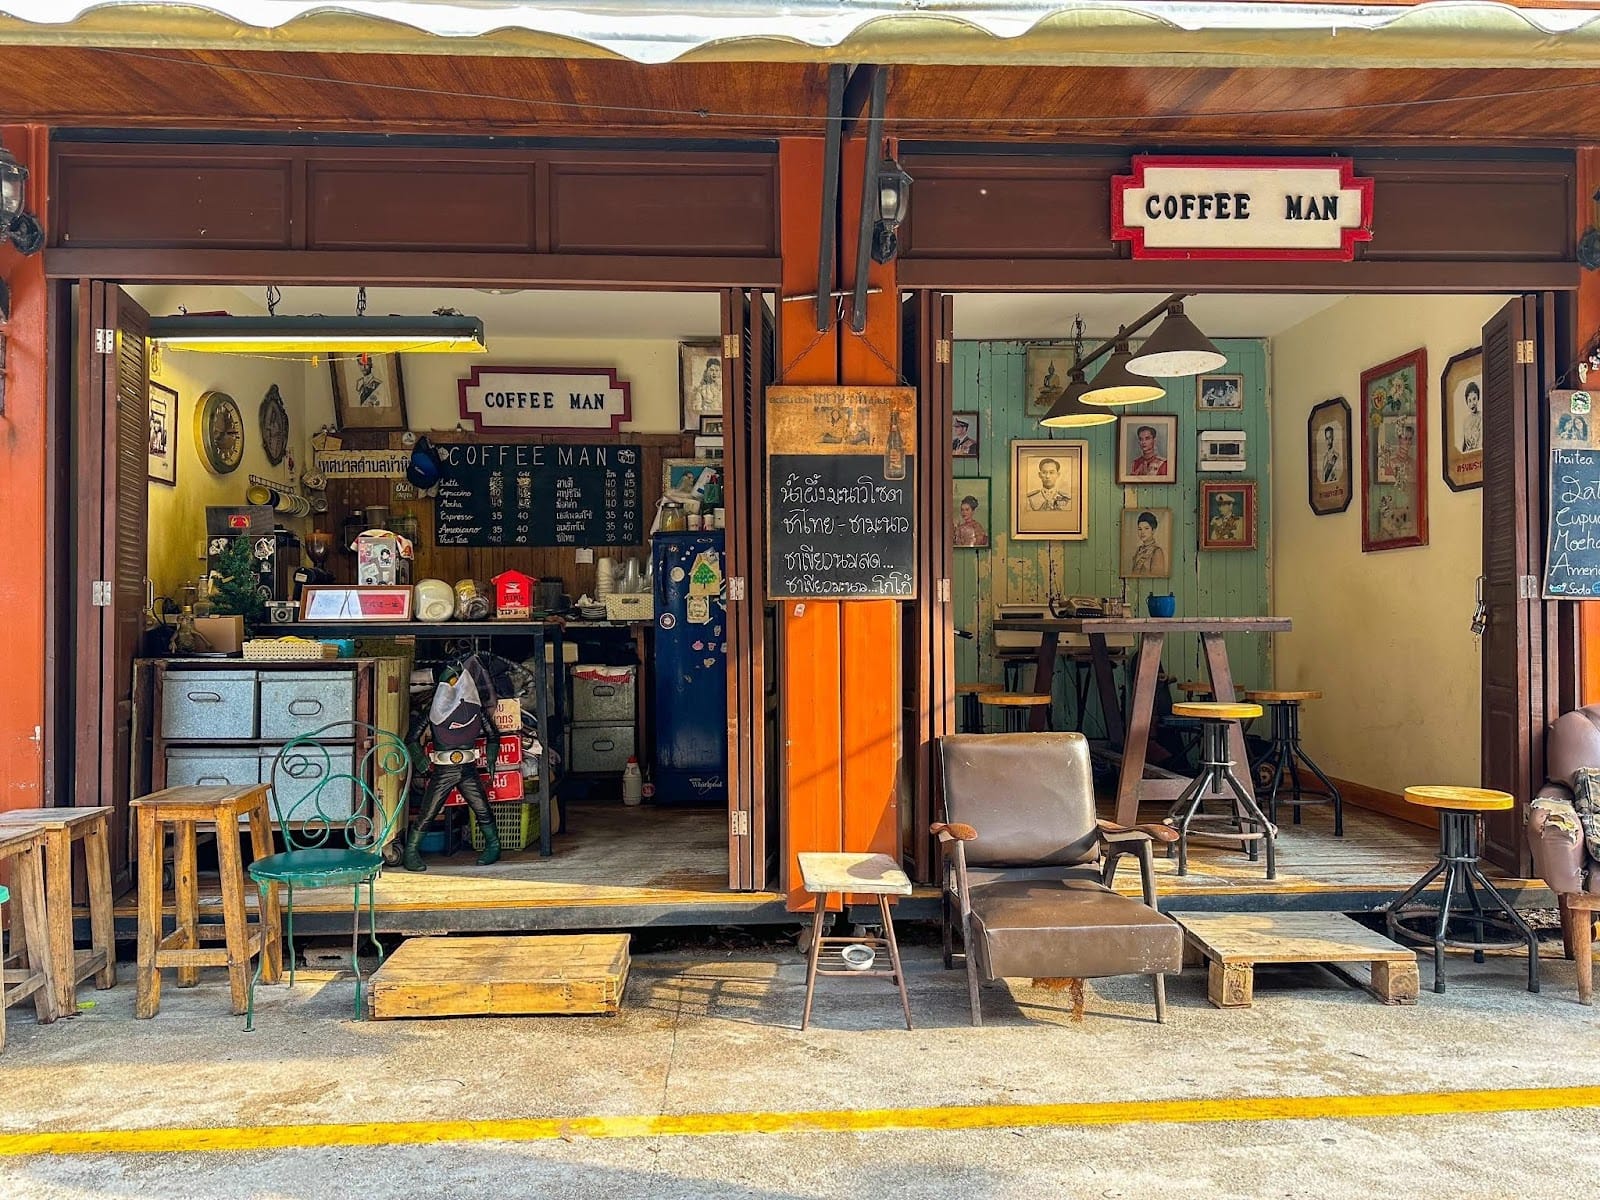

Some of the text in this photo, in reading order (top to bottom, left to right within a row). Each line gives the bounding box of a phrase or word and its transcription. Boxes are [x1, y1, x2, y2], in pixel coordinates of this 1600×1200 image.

[1145, 193, 1338, 221] COFFEE MAN
[485, 392, 604, 410] COFFEE MAN
[450, 445, 607, 466] COFFEE MAN
[605, 479, 616, 488] 40
[605, 499, 616, 508] 40
[491, 511, 503, 520] 35
[517, 511, 529, 520] 40
[605, 511, 616, 520] 35
[623, 511, 635, 520] 40
[439, 523, 529, 534] Americano 35 40
[605, 521, 616, 531] 35
[623, 522, 634, 531] 40
[605, 532, 616, 542] 35
[622, 532, 633, 541] 40
[1566, 582, 1591, 595] Soda
